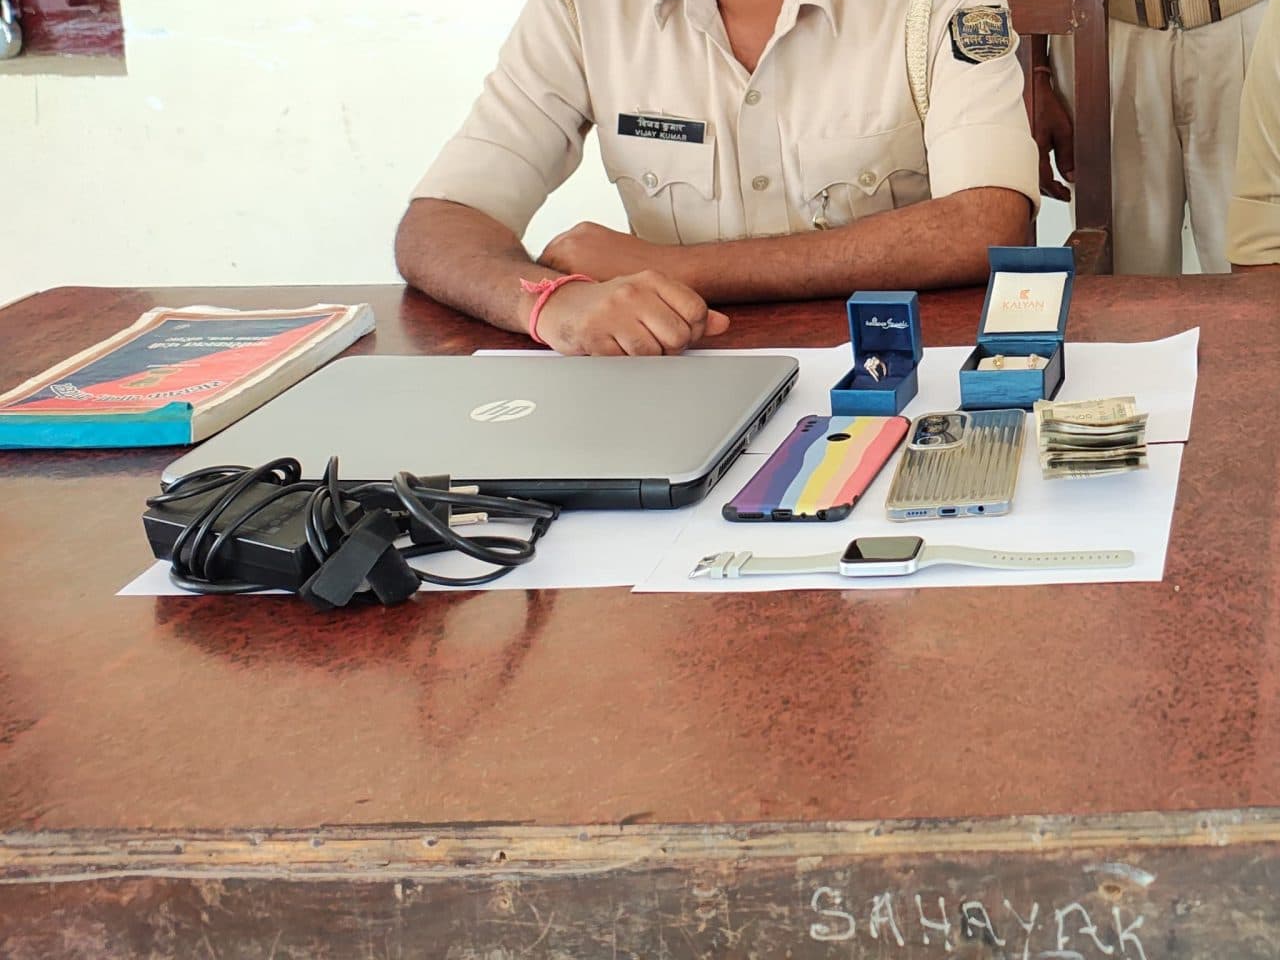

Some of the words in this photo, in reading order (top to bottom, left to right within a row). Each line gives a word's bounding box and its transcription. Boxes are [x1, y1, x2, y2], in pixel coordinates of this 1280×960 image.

[634, 128, 657, 138] VIJAY
[658, 130, 688, 141] KUMAR
[1002, 300, 1045, 311] KALYAN
